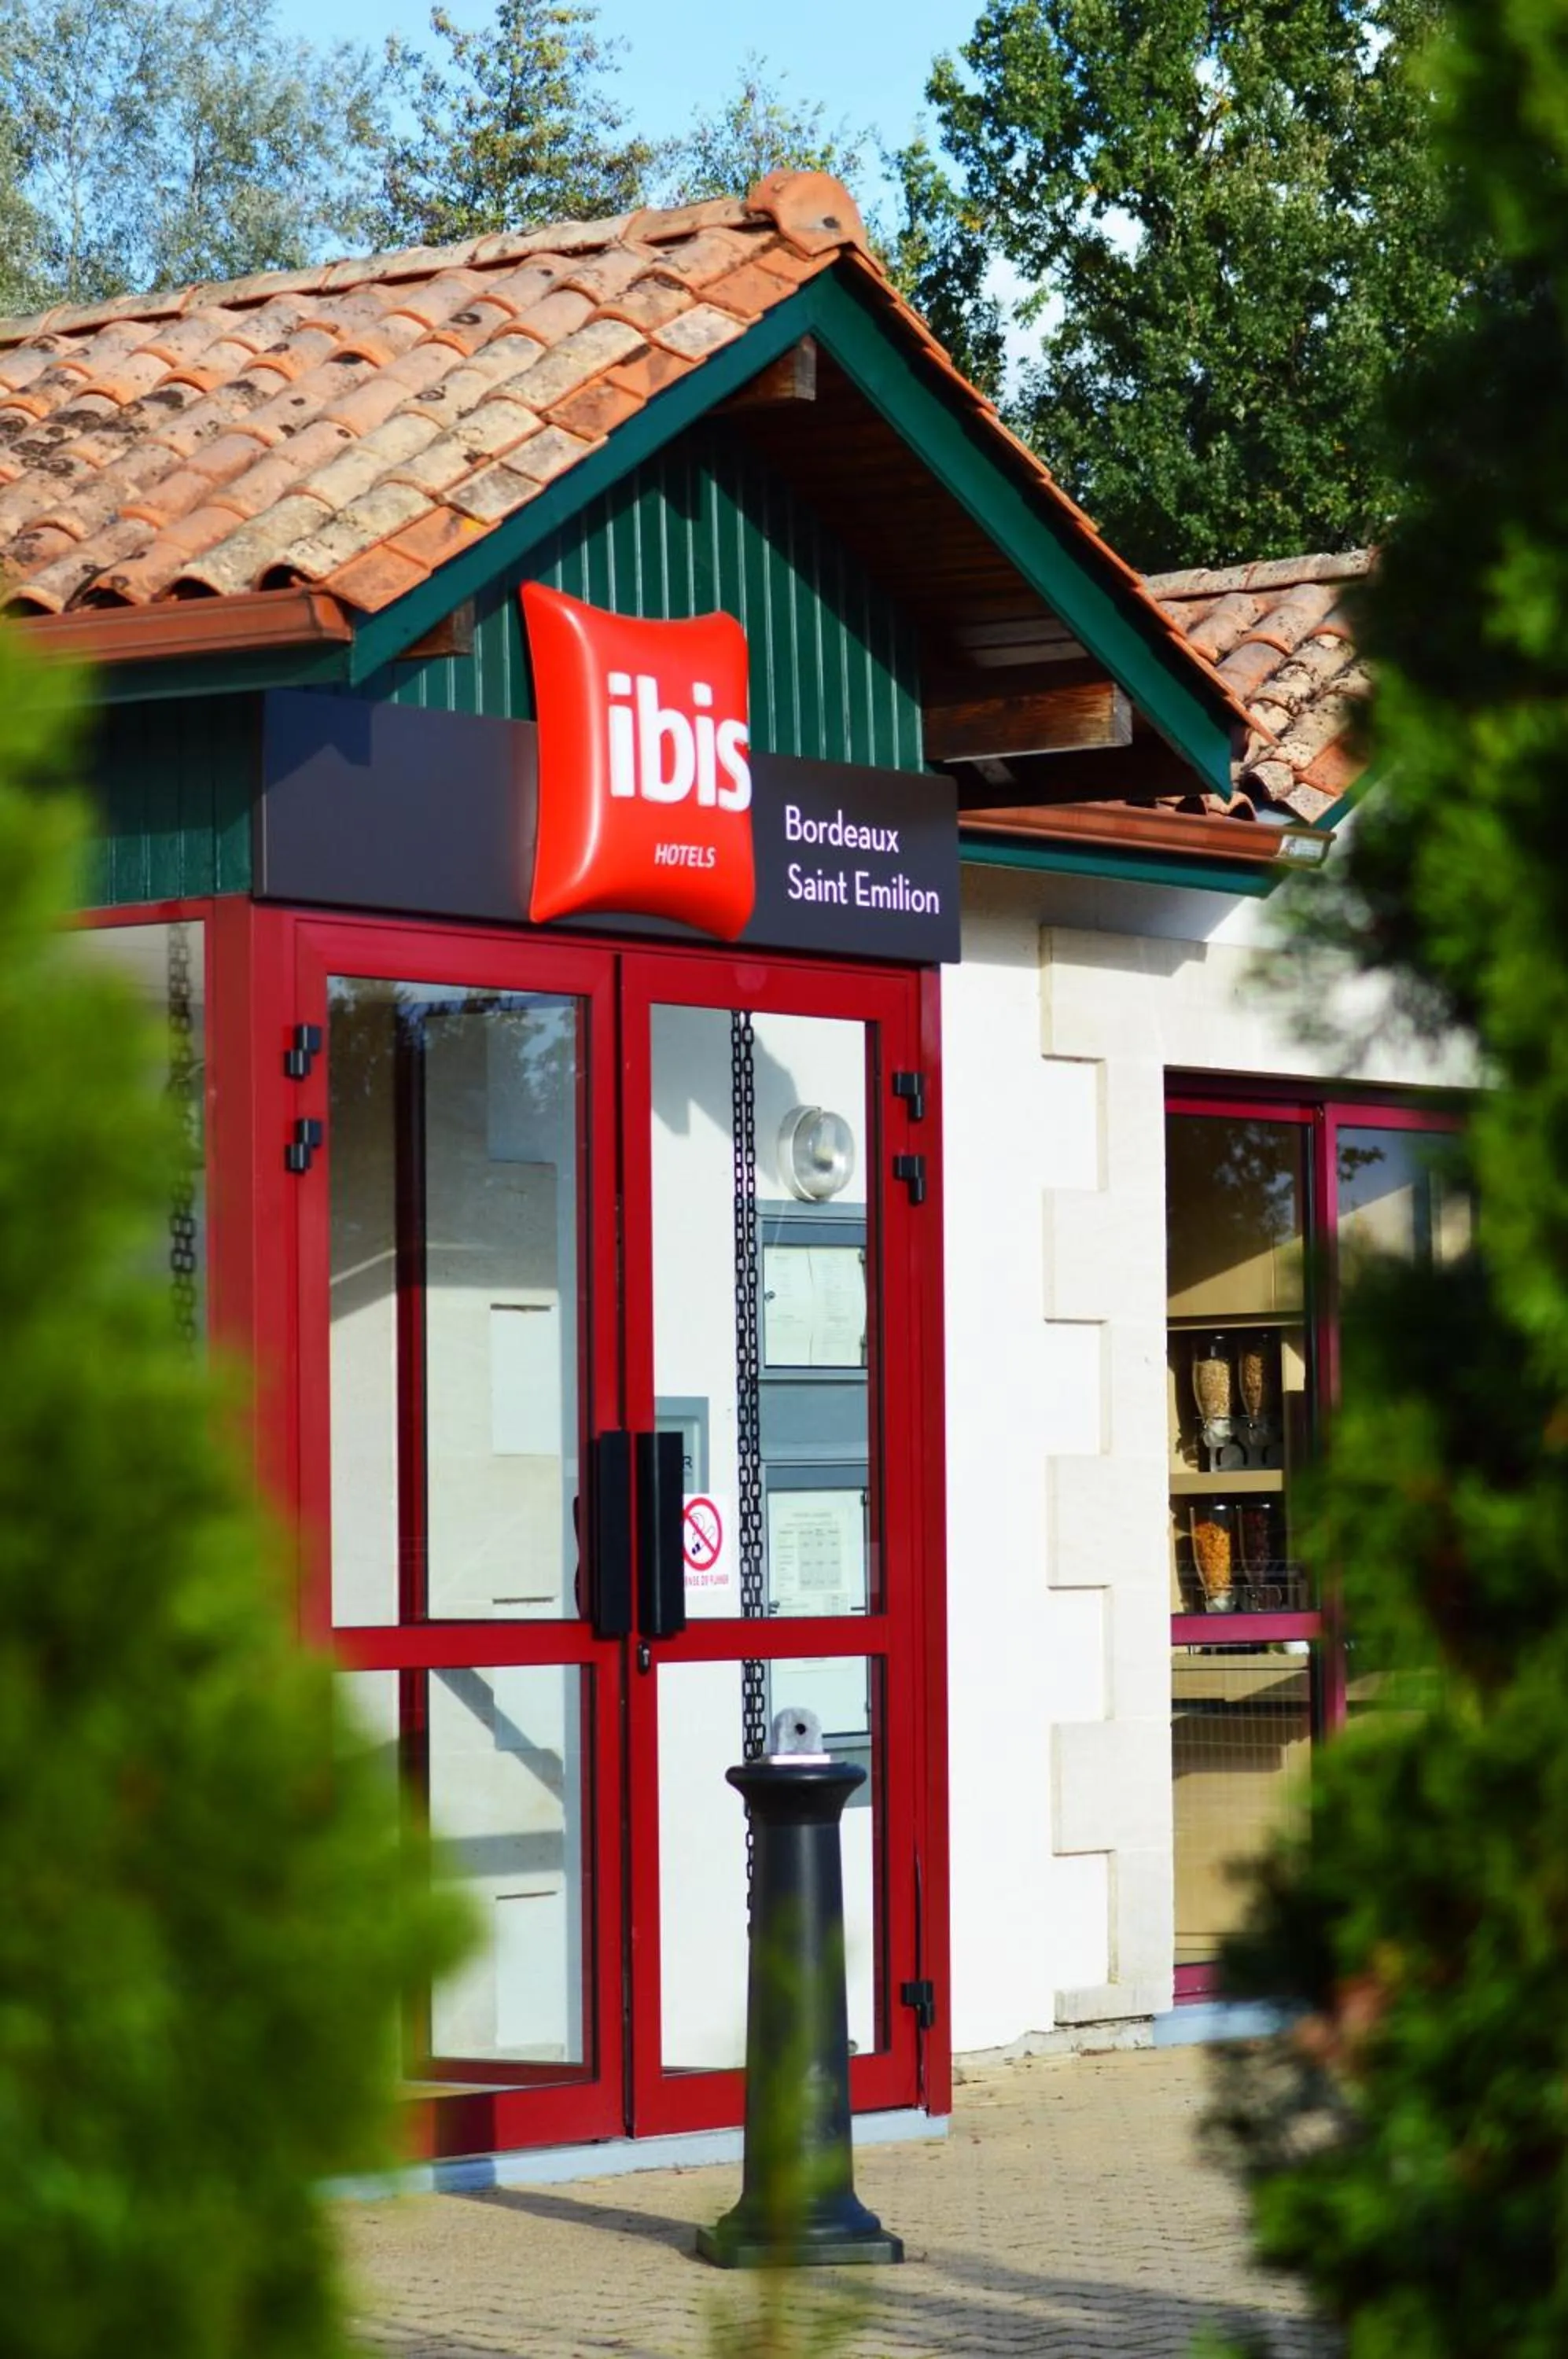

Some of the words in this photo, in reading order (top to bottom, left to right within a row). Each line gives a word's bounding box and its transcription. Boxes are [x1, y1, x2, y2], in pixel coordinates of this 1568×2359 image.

[608, 672, 752, 812] ibis
[786, 804, 899, 853] Bordeaux
[654, 843, 716, 868] HOTELS
[787, 863, 848, 905] Saint
[856, 870, 939, 914] Emilion
